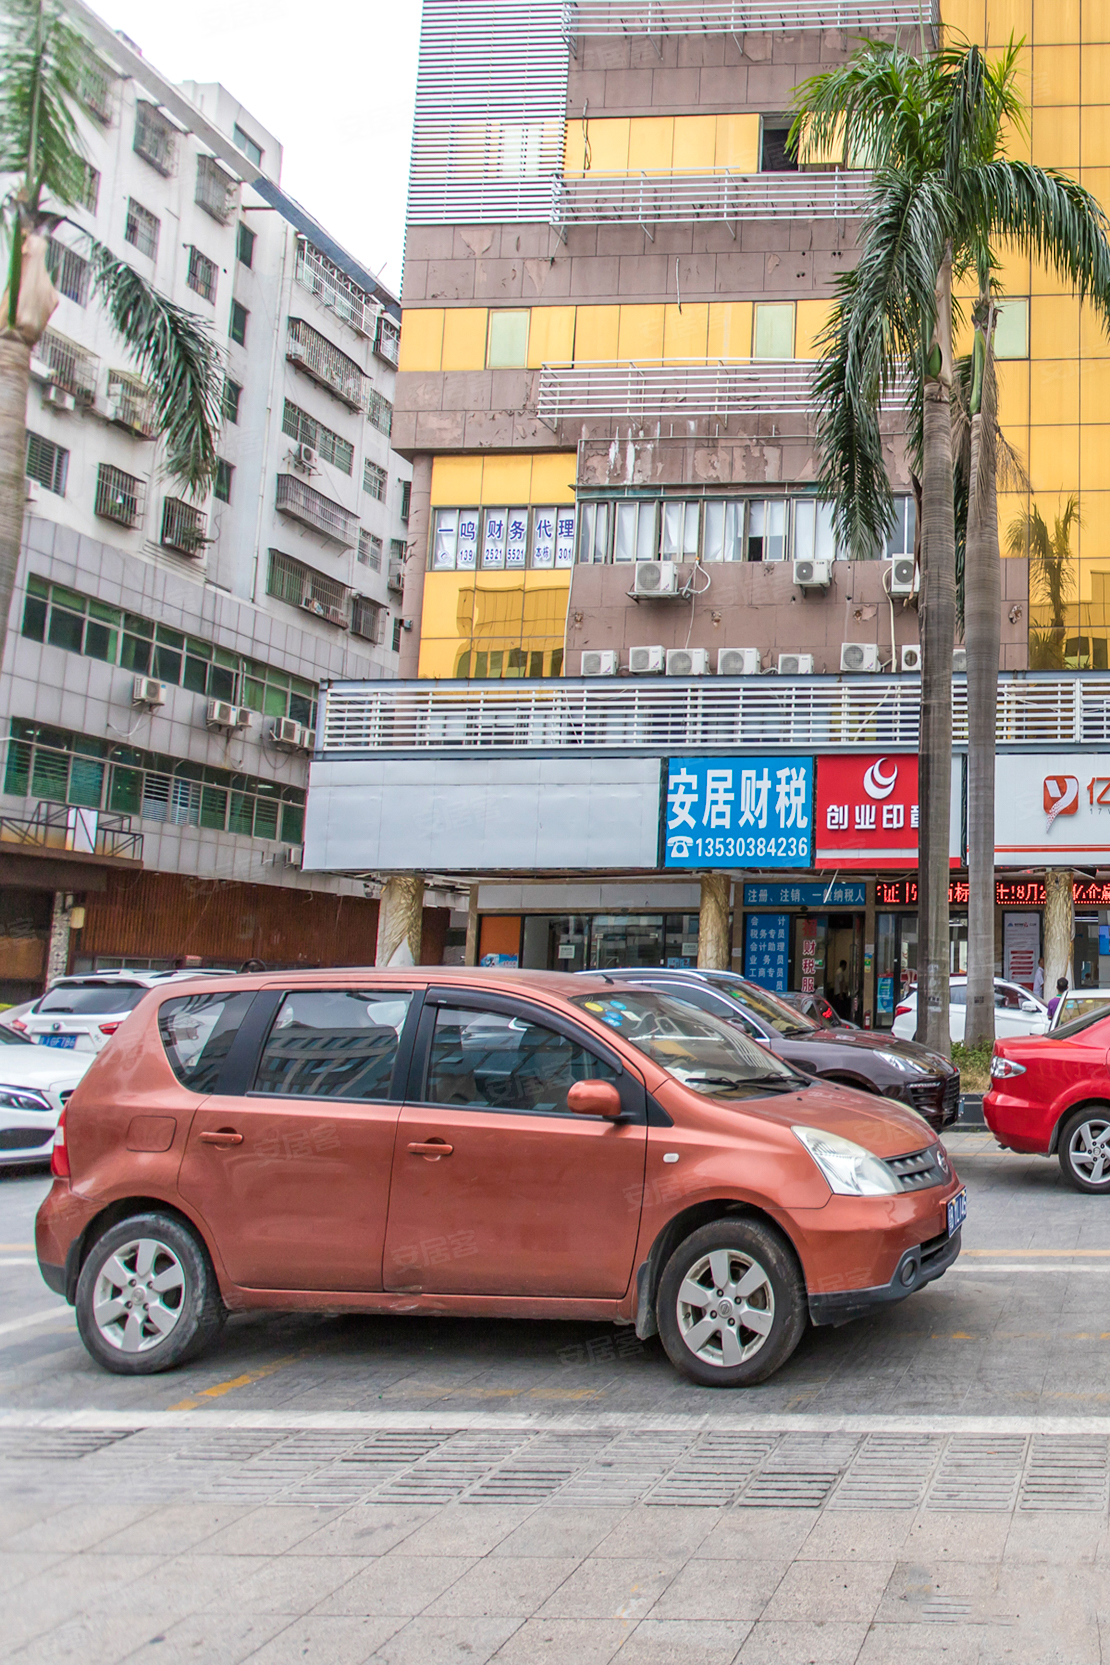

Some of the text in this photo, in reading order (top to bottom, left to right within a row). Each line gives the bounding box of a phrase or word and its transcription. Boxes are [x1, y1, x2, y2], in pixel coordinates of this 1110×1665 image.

[438, 519, 574, 540] 一鸣财务代理
[460, 549, 474, 561] 139
[485, 548, 502, 560] 2521
[507, 549, 524, 560] 5521
[558, 547, 572, 559] 301
[667, 767, 808, 829] 安居财税
[696, 837, 808, 857] 13530384236
[750, 929, 786, 939] 税务专员
[749, 942, 785, 952] 会计助理
[749, 955, 784, 965] 业务员
[749, 968, 784, 978] 工商专员
